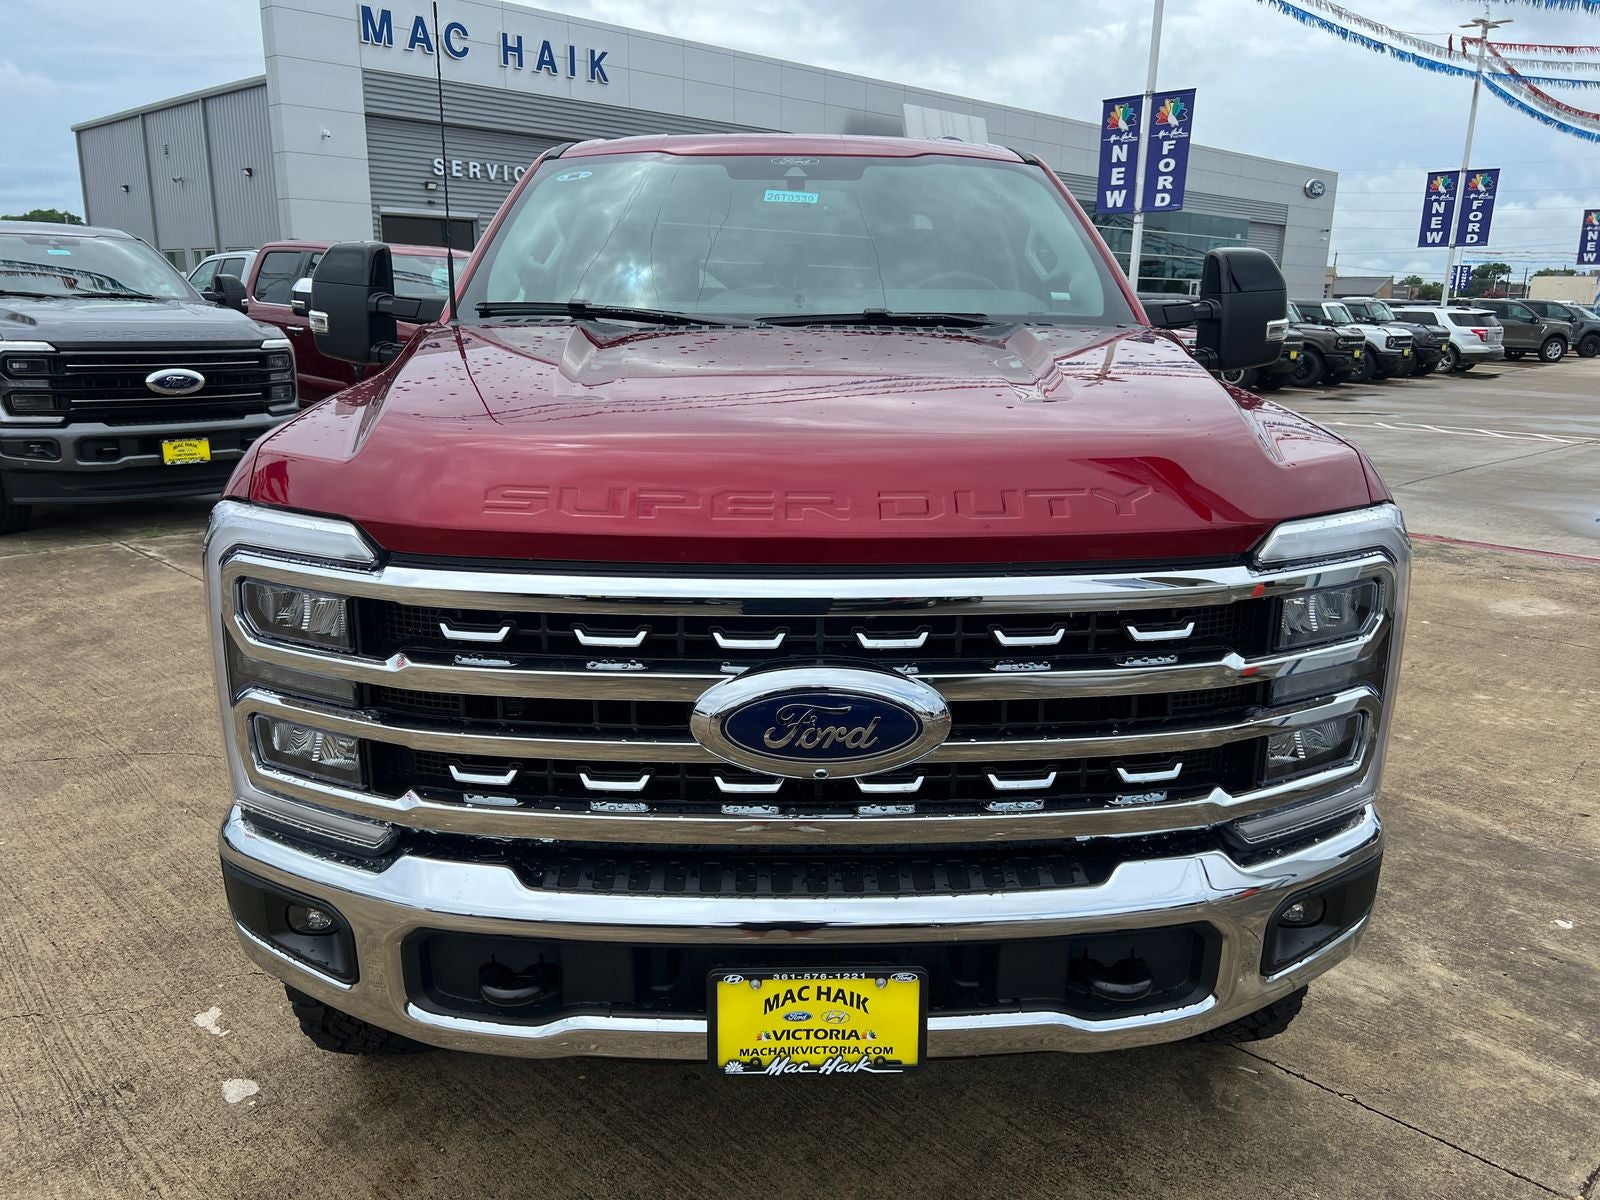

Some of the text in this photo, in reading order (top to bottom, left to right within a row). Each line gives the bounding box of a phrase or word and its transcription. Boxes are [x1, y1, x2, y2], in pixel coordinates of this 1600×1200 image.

[358, 4, 609, 84] MAC HAIK
[1105, 144, 1128, 208] NEW
[1154, 140, 1176, 207] FORD
[1426, 202, 1445, 243] NEW
[1465, 200, 1483, 243] FORD
[1583, 231, 1598, 262] NEW
[164, 375, 191, 387] Ford
[483, 485, 1154, 521] SUPER DUTY
[763, 703, 882, 749] Ford
[773, 972, 866, 981] 361-576-1221
[763, 986, 870, 1015] MAC HAIK
[739, 1045, 894, 1056] MACHAIKVICTORIA.COM
[772, 1028, 861, 1041] VICTORIA
[764, 1055, 874, 1076] Mac Haik
